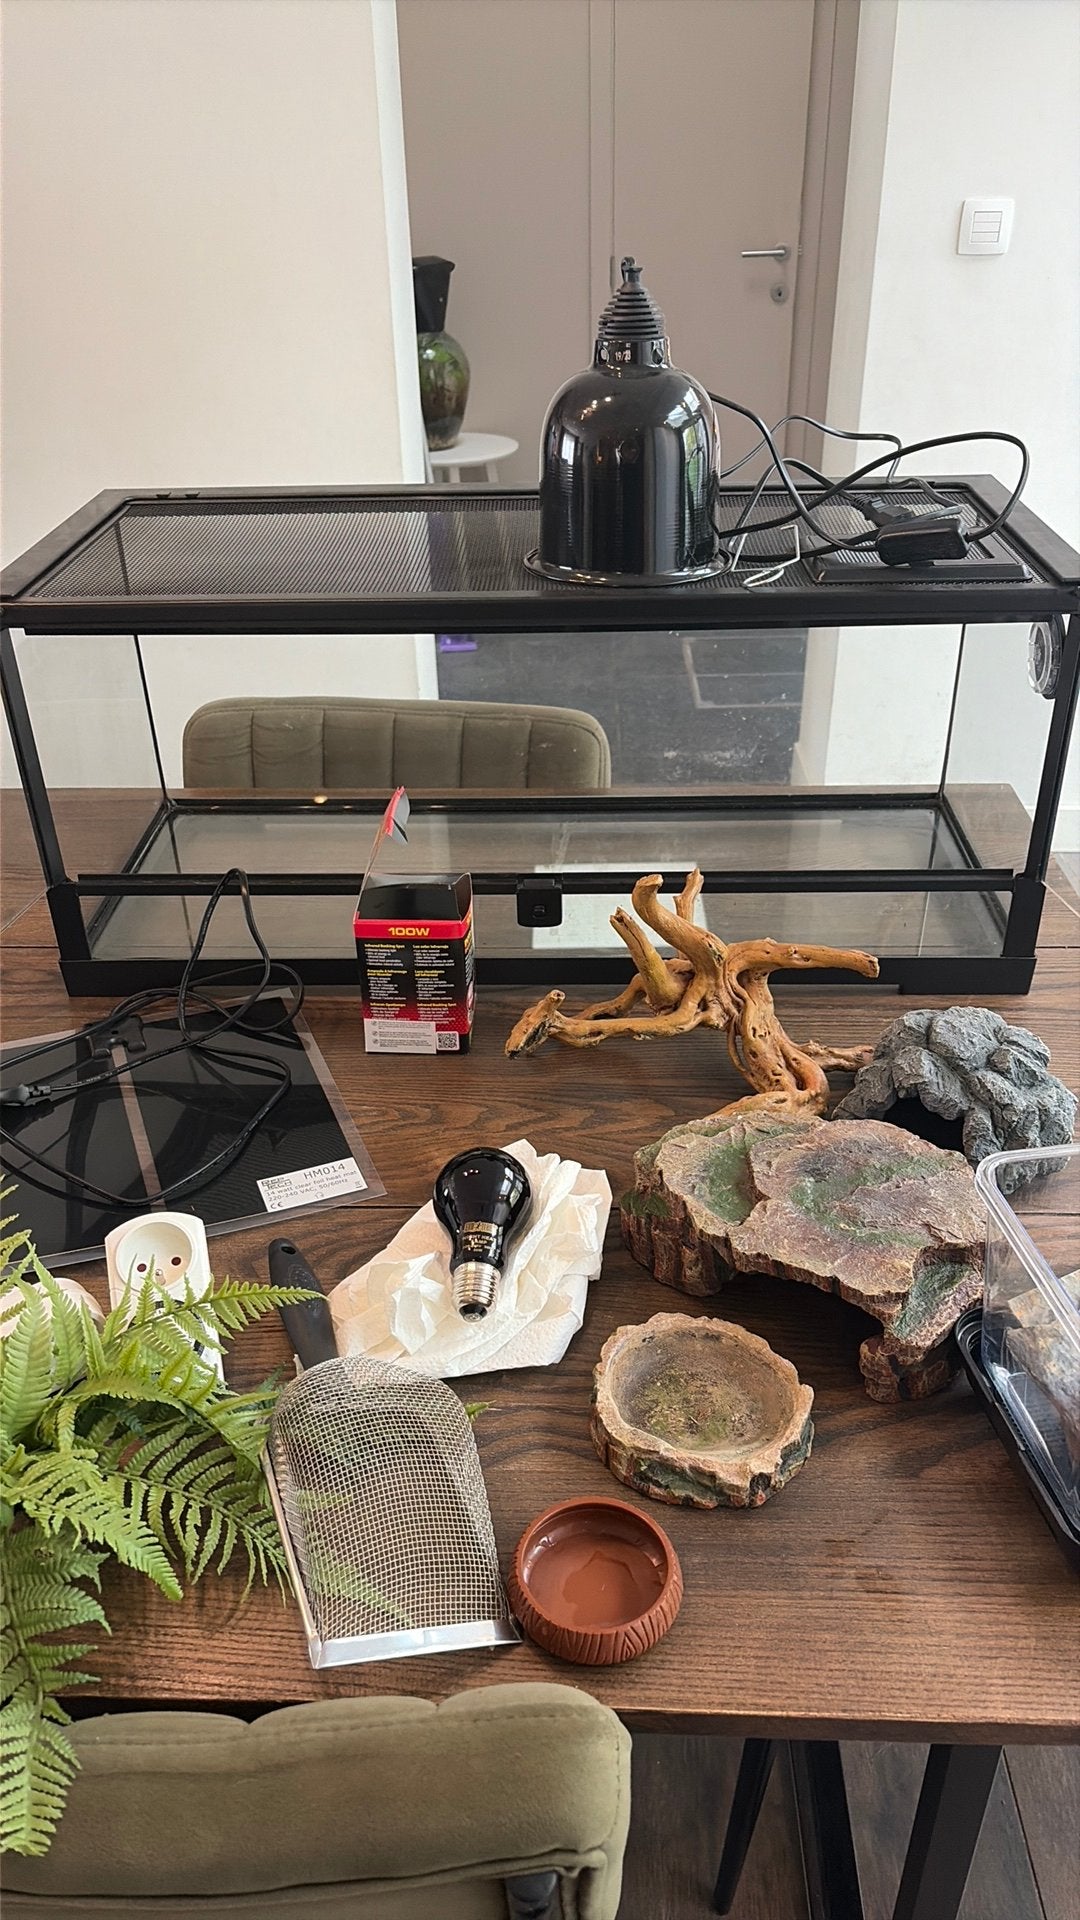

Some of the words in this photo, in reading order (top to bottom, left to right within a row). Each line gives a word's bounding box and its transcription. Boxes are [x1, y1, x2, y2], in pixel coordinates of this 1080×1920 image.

[388, 927, 430, 936] 100W
[303, 1163, 345, 1179] HM014
[269, 1191, 299, 1202] 220-240
[300, 1186, 317, 1195] VAC,
[319, 1178, 348, 1189] 50/60Hz
